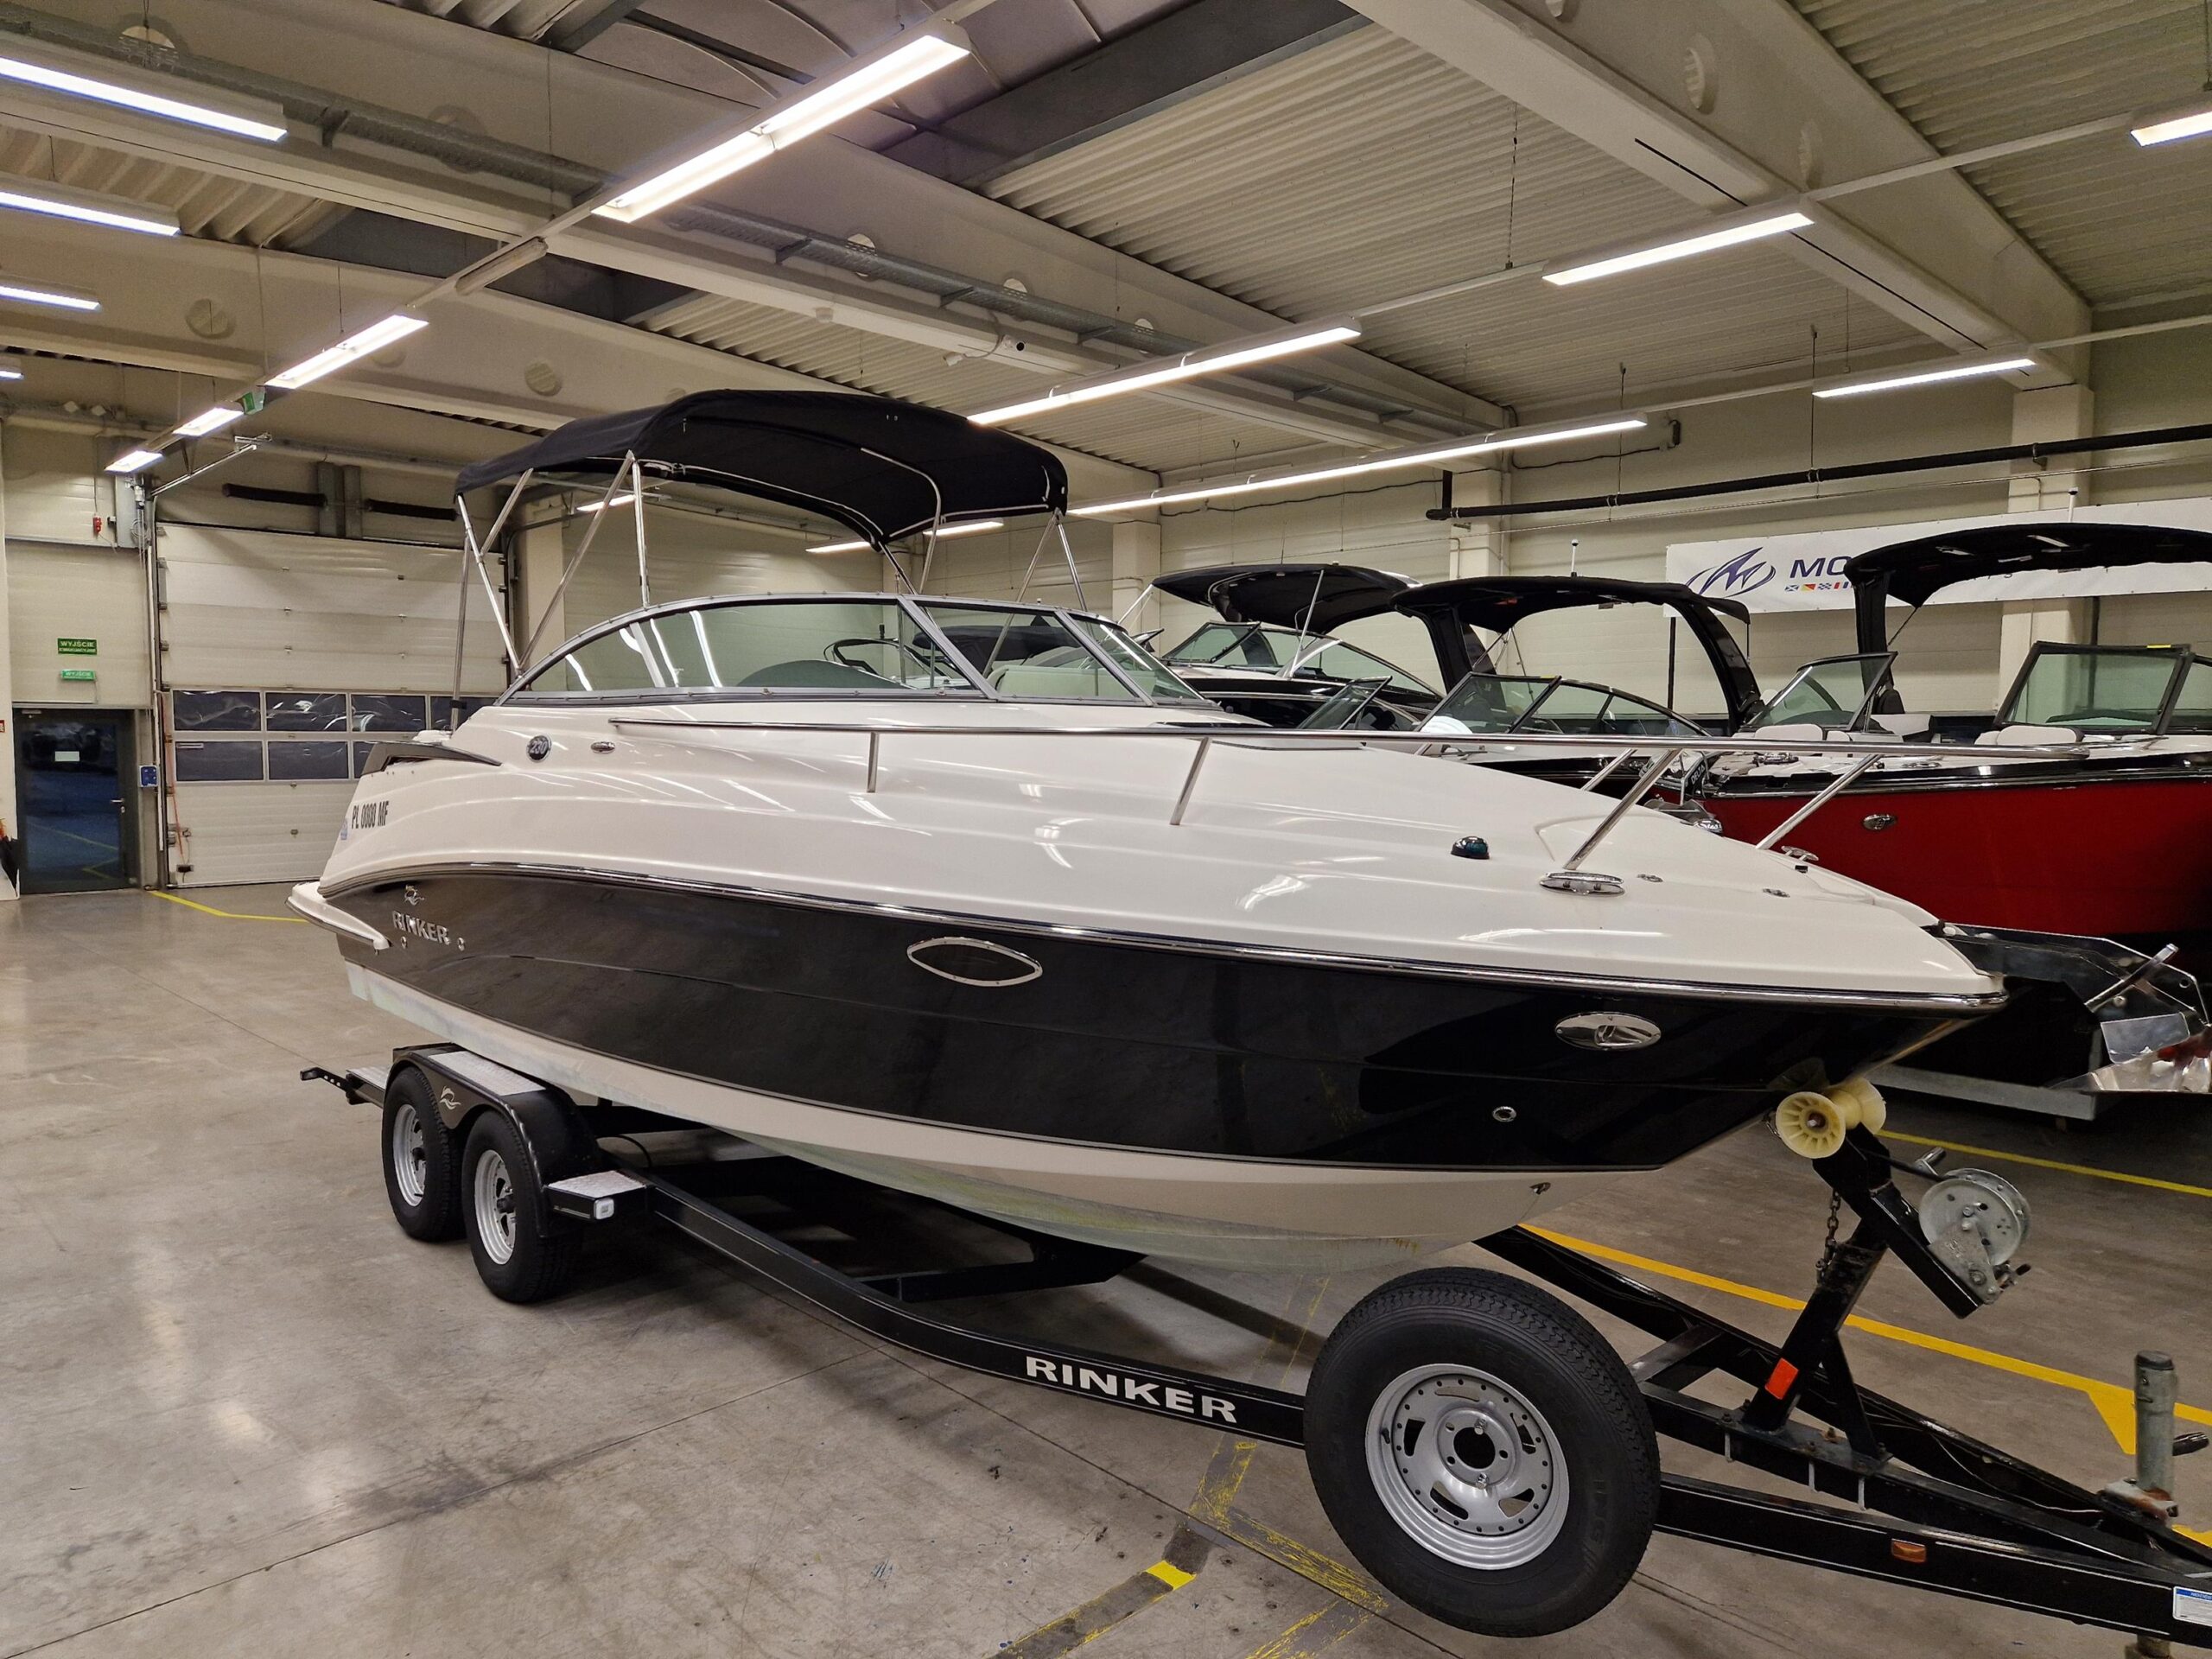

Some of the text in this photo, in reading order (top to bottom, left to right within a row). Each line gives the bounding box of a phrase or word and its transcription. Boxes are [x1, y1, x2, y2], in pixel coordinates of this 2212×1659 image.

[352, 804, 359, 830] PL
[378, 800, 389, 827] MF
[392, 911, 450, 945] RINKER
[1026, 1356, 1237, 1424] RINKER
